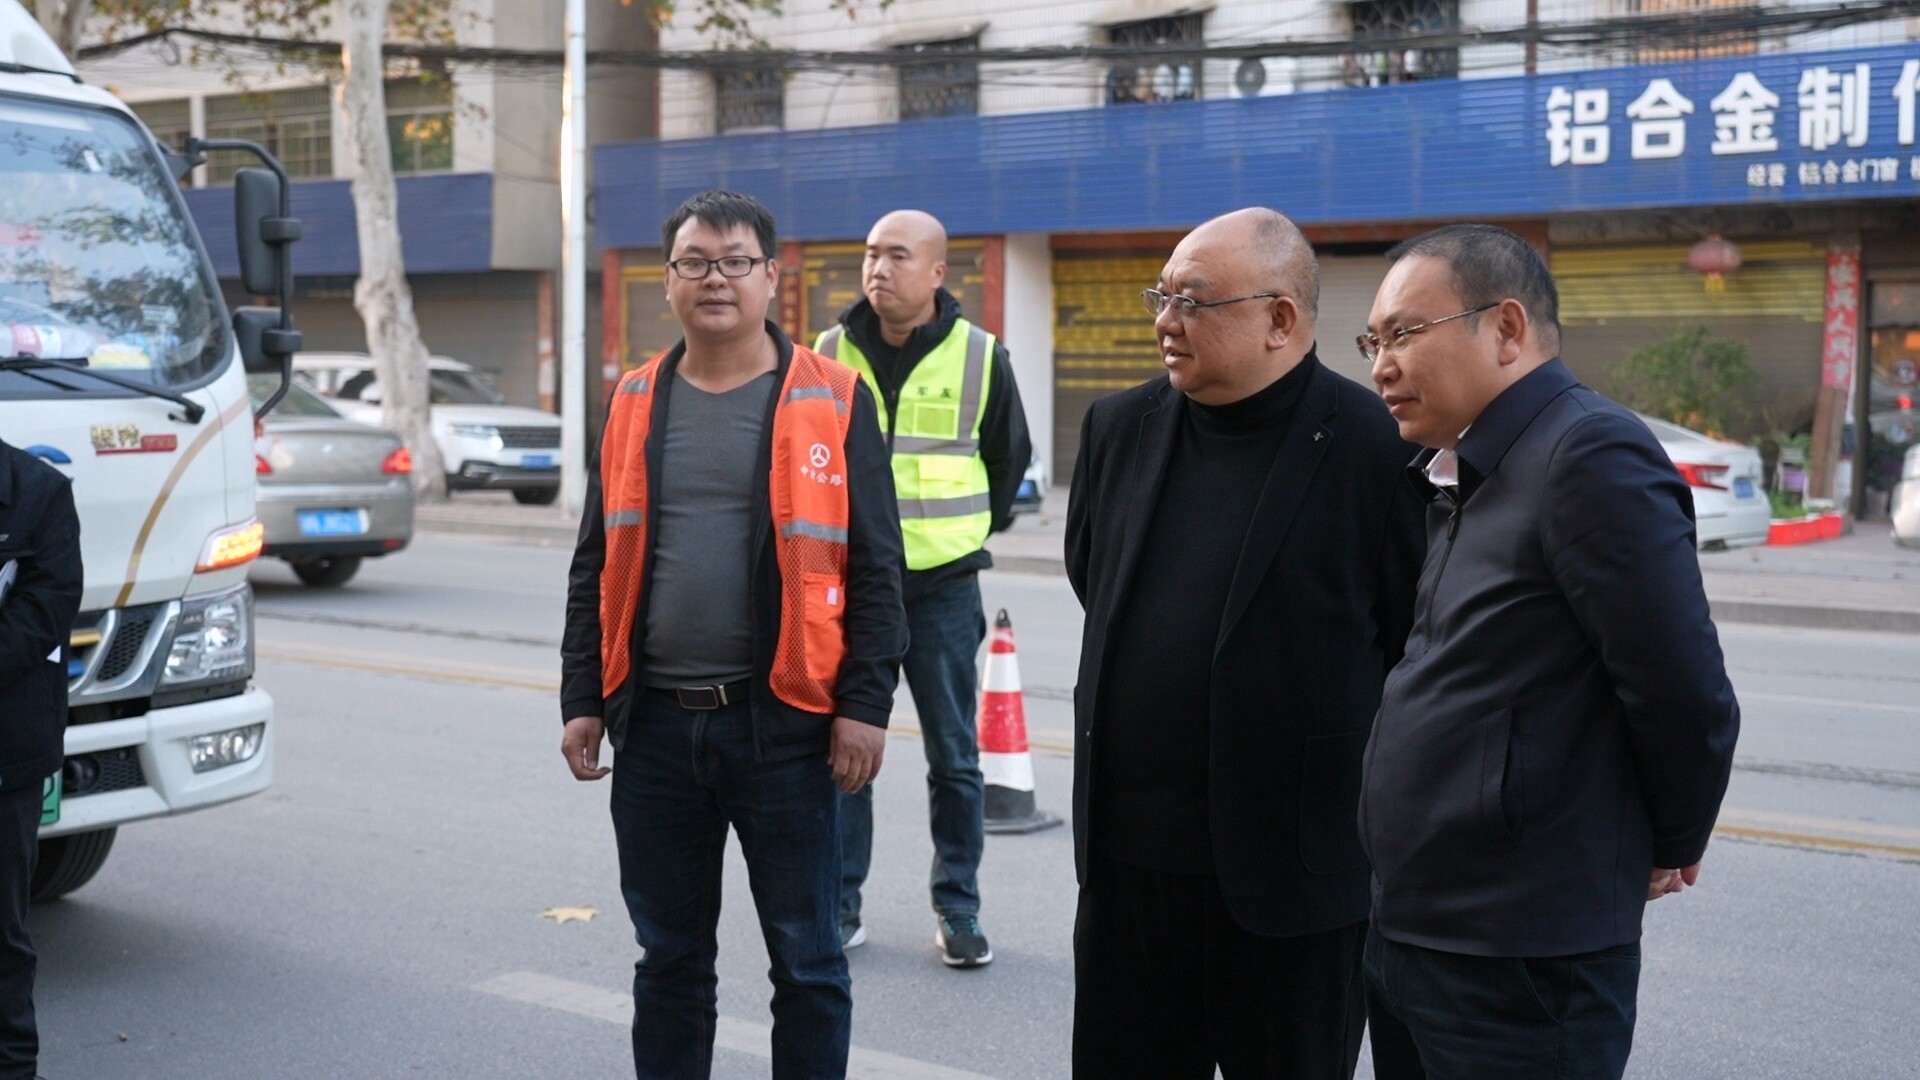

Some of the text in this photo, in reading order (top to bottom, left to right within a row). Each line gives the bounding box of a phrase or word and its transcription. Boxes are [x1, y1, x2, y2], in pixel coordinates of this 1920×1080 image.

[1798, 156, 1899, 185] 铝合金门窗
